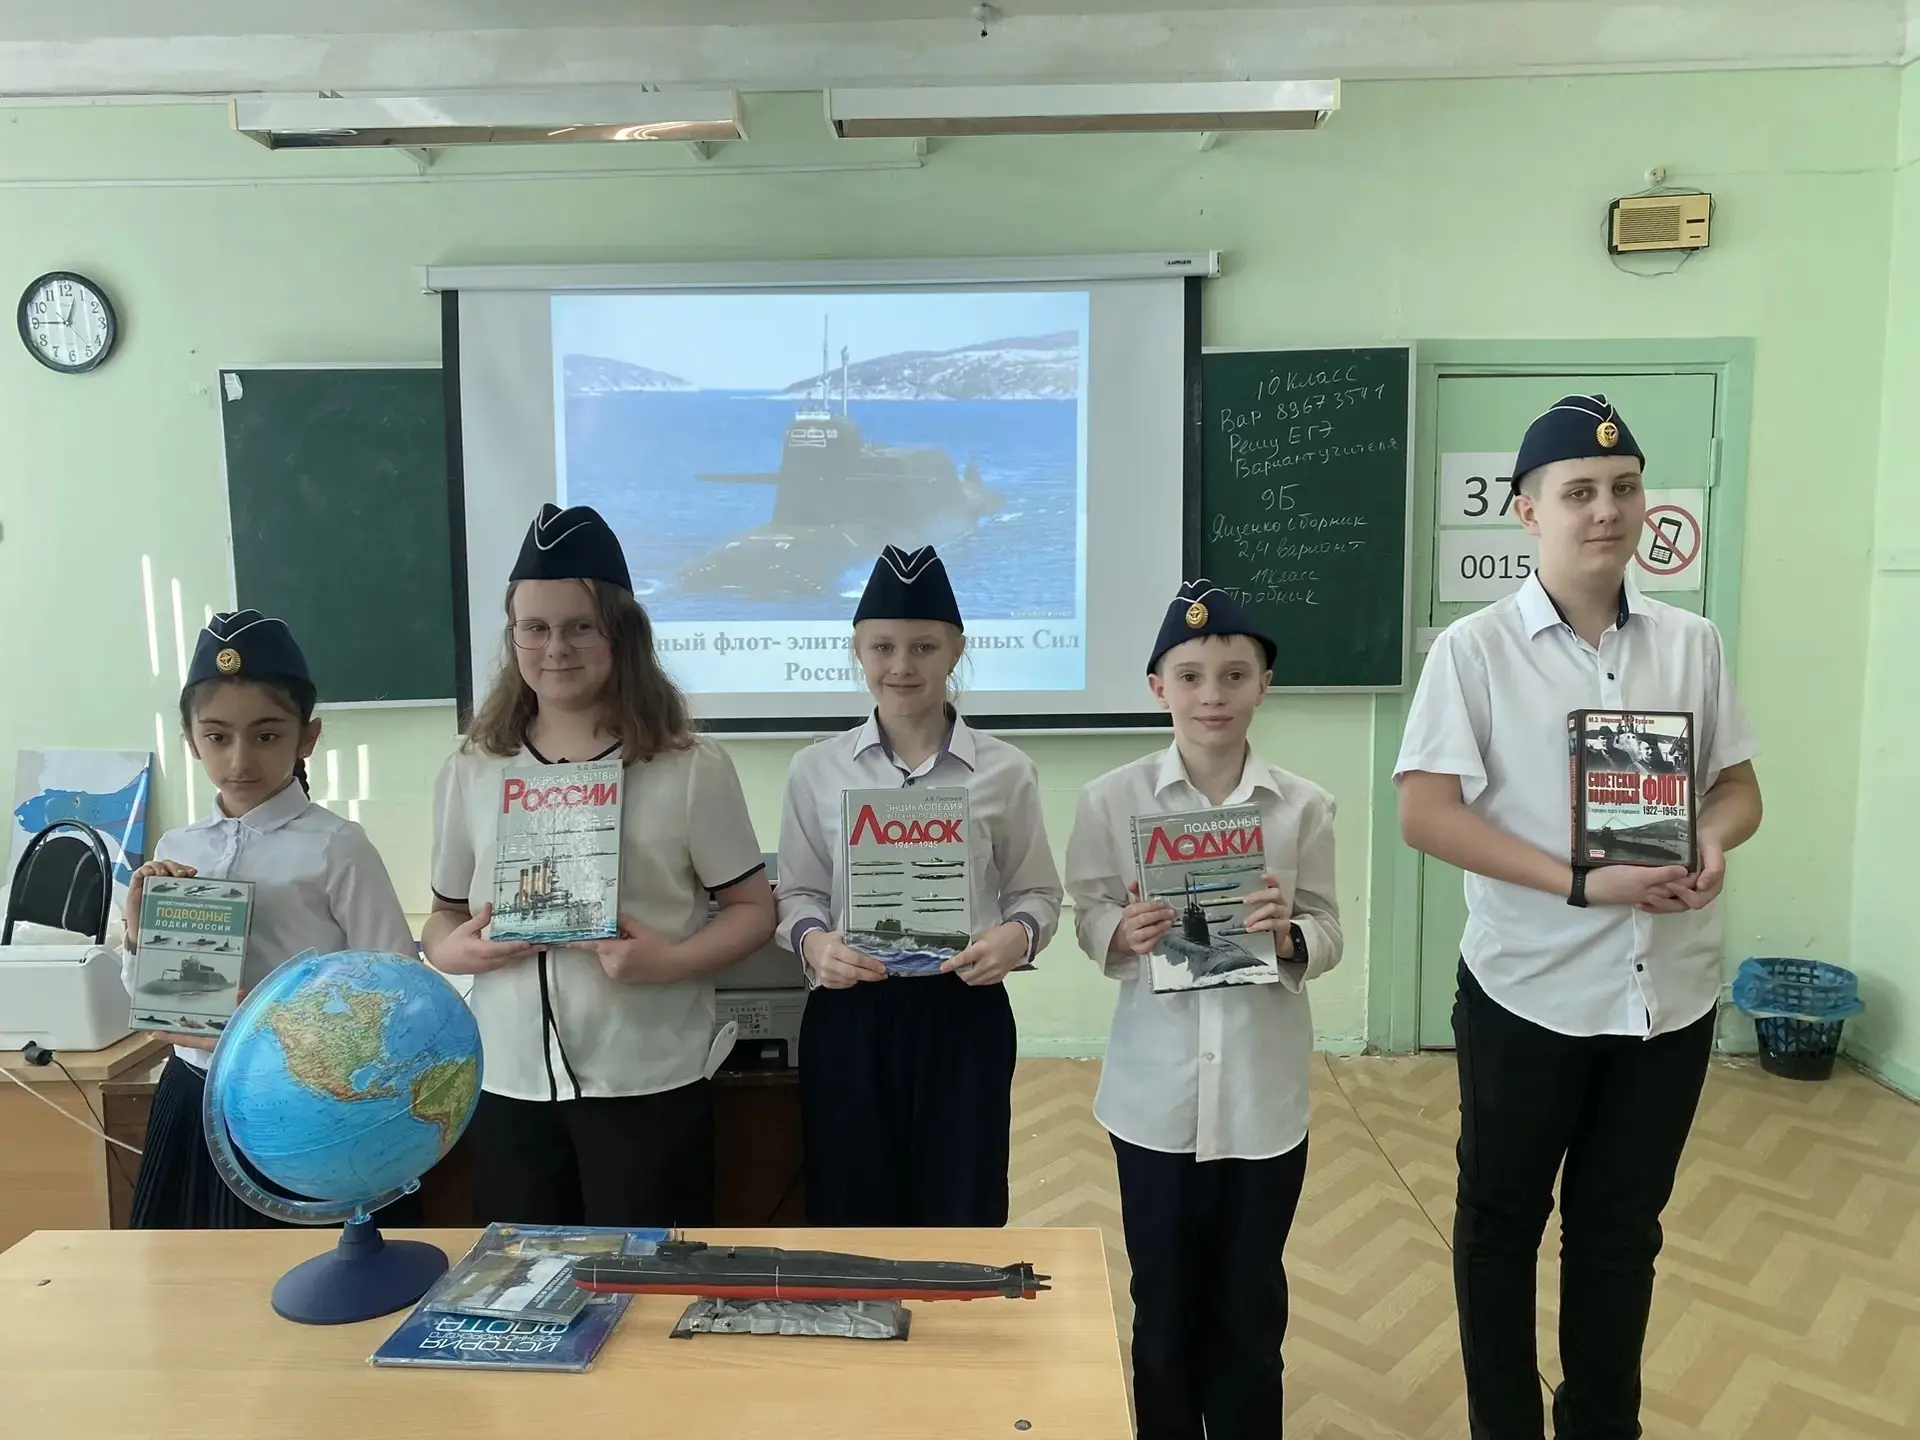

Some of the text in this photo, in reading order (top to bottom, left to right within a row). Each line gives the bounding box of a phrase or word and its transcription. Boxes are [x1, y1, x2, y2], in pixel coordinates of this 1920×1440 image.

[45, 290, 54, 302] 11
[59, 284, 73, 297] 12
[80, 289, 84, 301] 1
[35, 301, 47, 314] 10
[91, 301, 99, 314] 2
[31, 317, 40, 330] 9
[98, 316, 107, 330] 3
[39, 333, 48, 346] 8
[94, 334, 102, 347] 4
[52, 345, 59, 358] 7
[68, 349, 77, 362] 6
[85, 345, 93, 358] 5
[1220, 408, 1262, 432] Вар
[1229, 420, 1334, 462] Решу ЕГЭ
[1261, 483, 1300, 511] 9Б
[1461, 554, 1531, 579] 0015
[656, 632, 706, 651] ный
[786, 635, 852, 651] элита
[1032, 629, 1081, 650] Сил
[583, 771, 618, 783] БИТВЫ
[1642, 774, 1687, 806] ФЛОТ
[886, 802, 963, 812] ЭНЦИКЛОПЕДИЯ
[849, 805, 964, 845] ЛОДОК
[1184, 816, 1261, 833] ПОДВОДНЫЕ
[1145, 826, 1264, 865] ЛОДКИ
[156, 907, 232, 923] ПОДВОДНЫЕ
[155, 919, 231, 932] ЛОДКИ РОССИИ
[435, 1317, 570, 1335] ФЛОТА
[419, 1337, 560, 1353] ИСТОРИЯ
